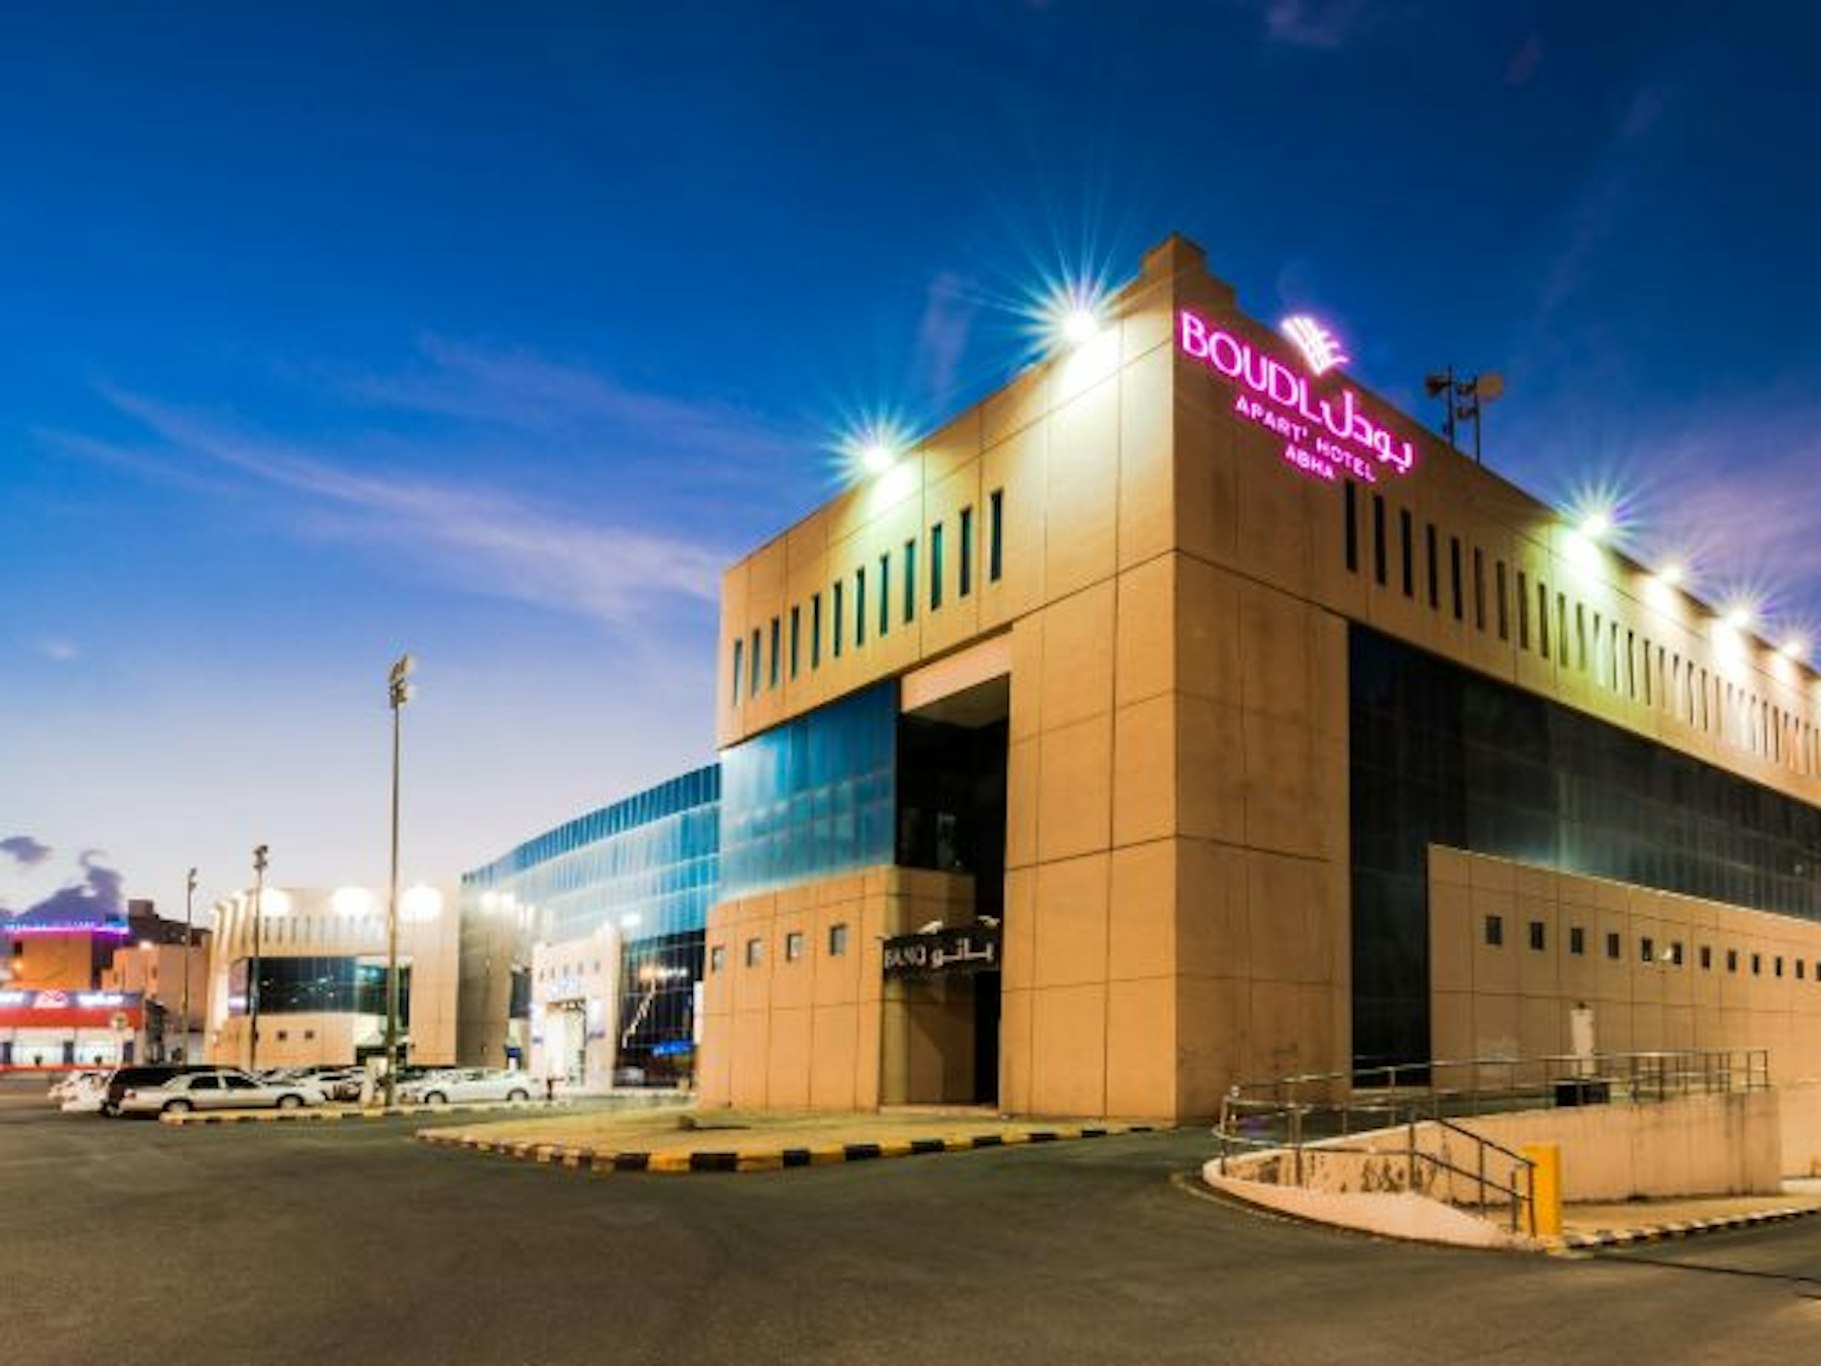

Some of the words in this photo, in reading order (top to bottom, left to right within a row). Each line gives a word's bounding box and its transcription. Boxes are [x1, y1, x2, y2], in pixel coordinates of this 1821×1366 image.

[1181, 311, 1321, 423] BOUDL
[1284, 445, 1336, 480] ABHA
[1315, 437, 1376, 482] HOTEL
